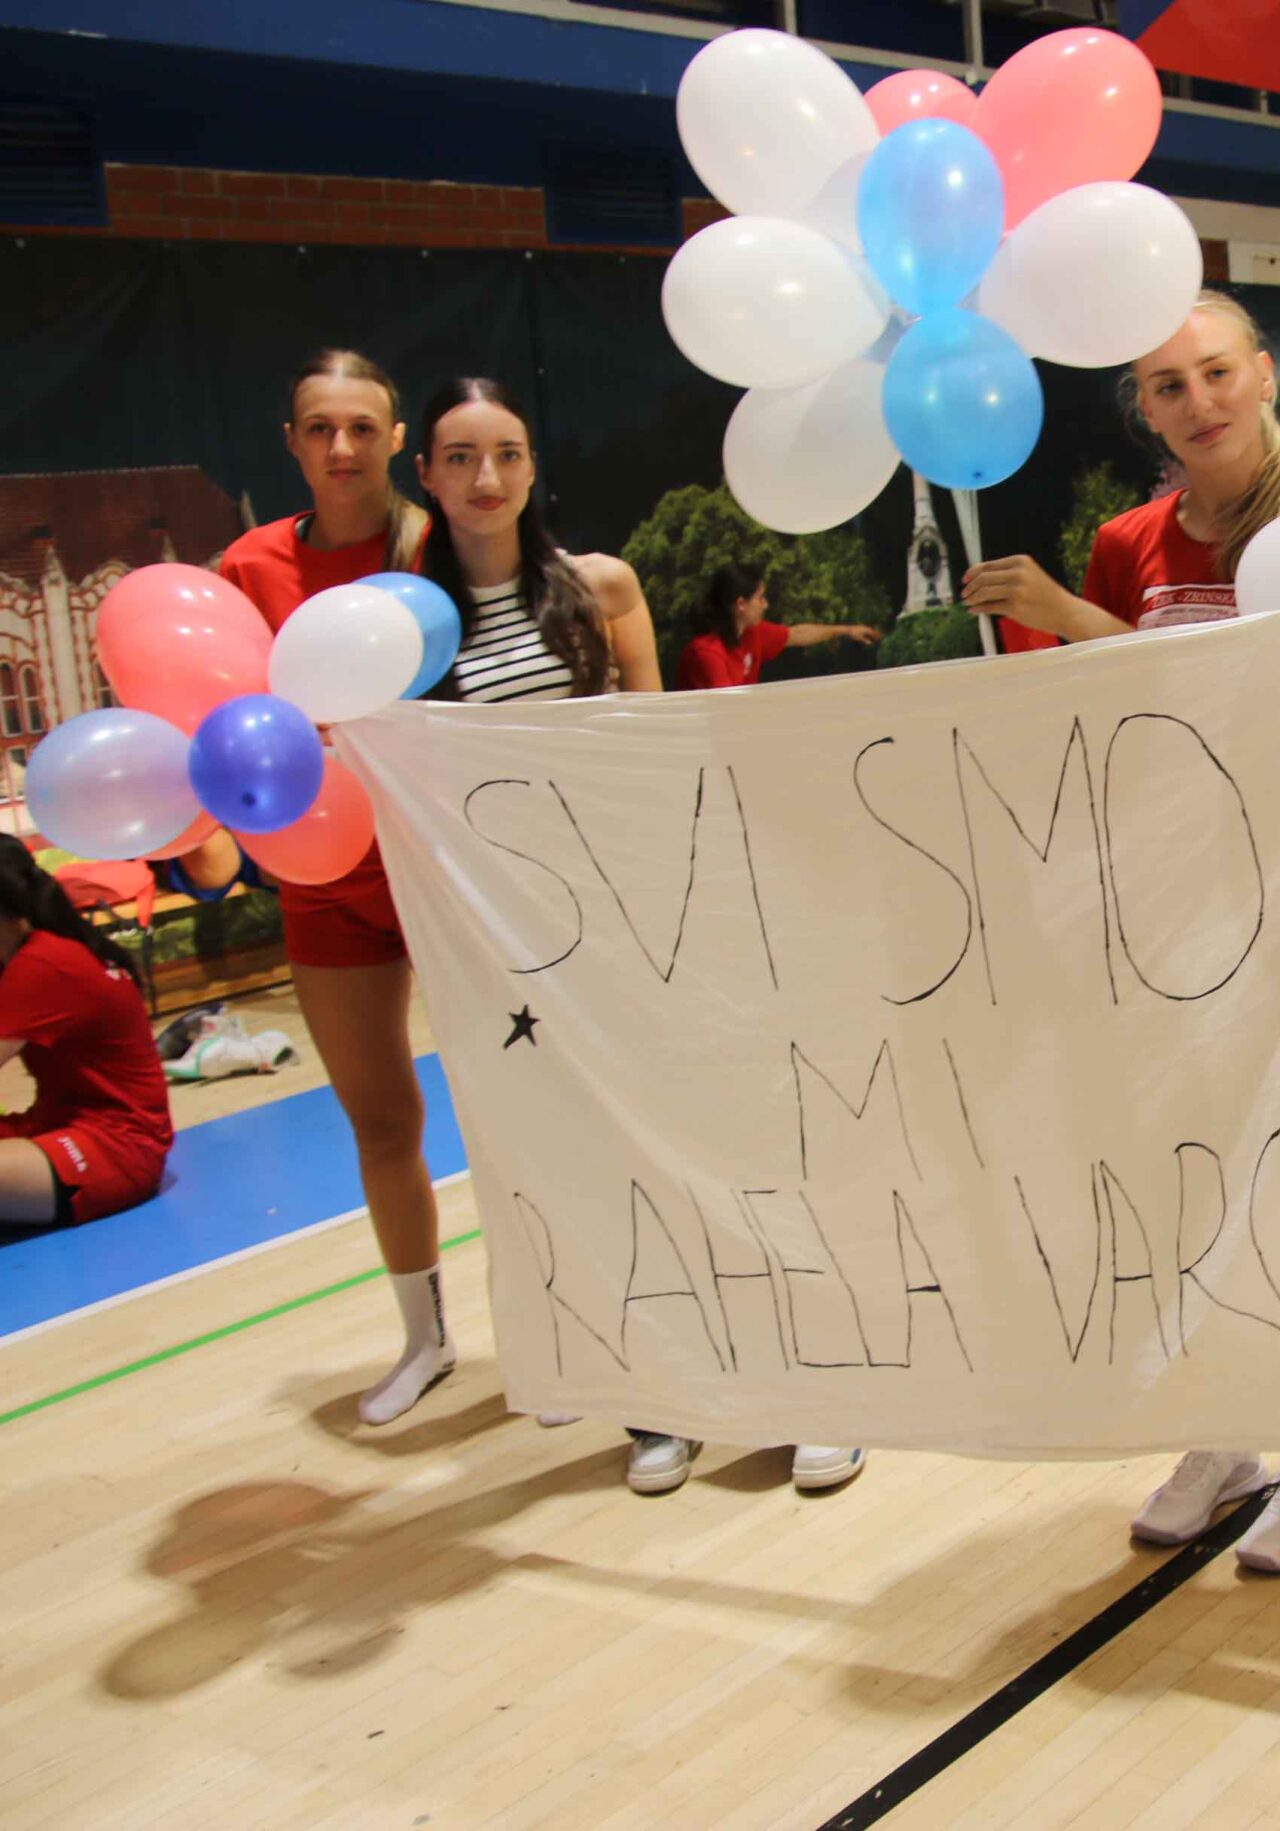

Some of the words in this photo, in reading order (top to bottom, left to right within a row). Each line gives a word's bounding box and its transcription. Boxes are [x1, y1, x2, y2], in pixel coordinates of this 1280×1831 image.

[463, 765, 779, 990] SVI
[853, 713, 1265, 1006] SMO
[790, 1037, 986, 1181] MI
[513, 1178, 974, 1377] RAHELA
